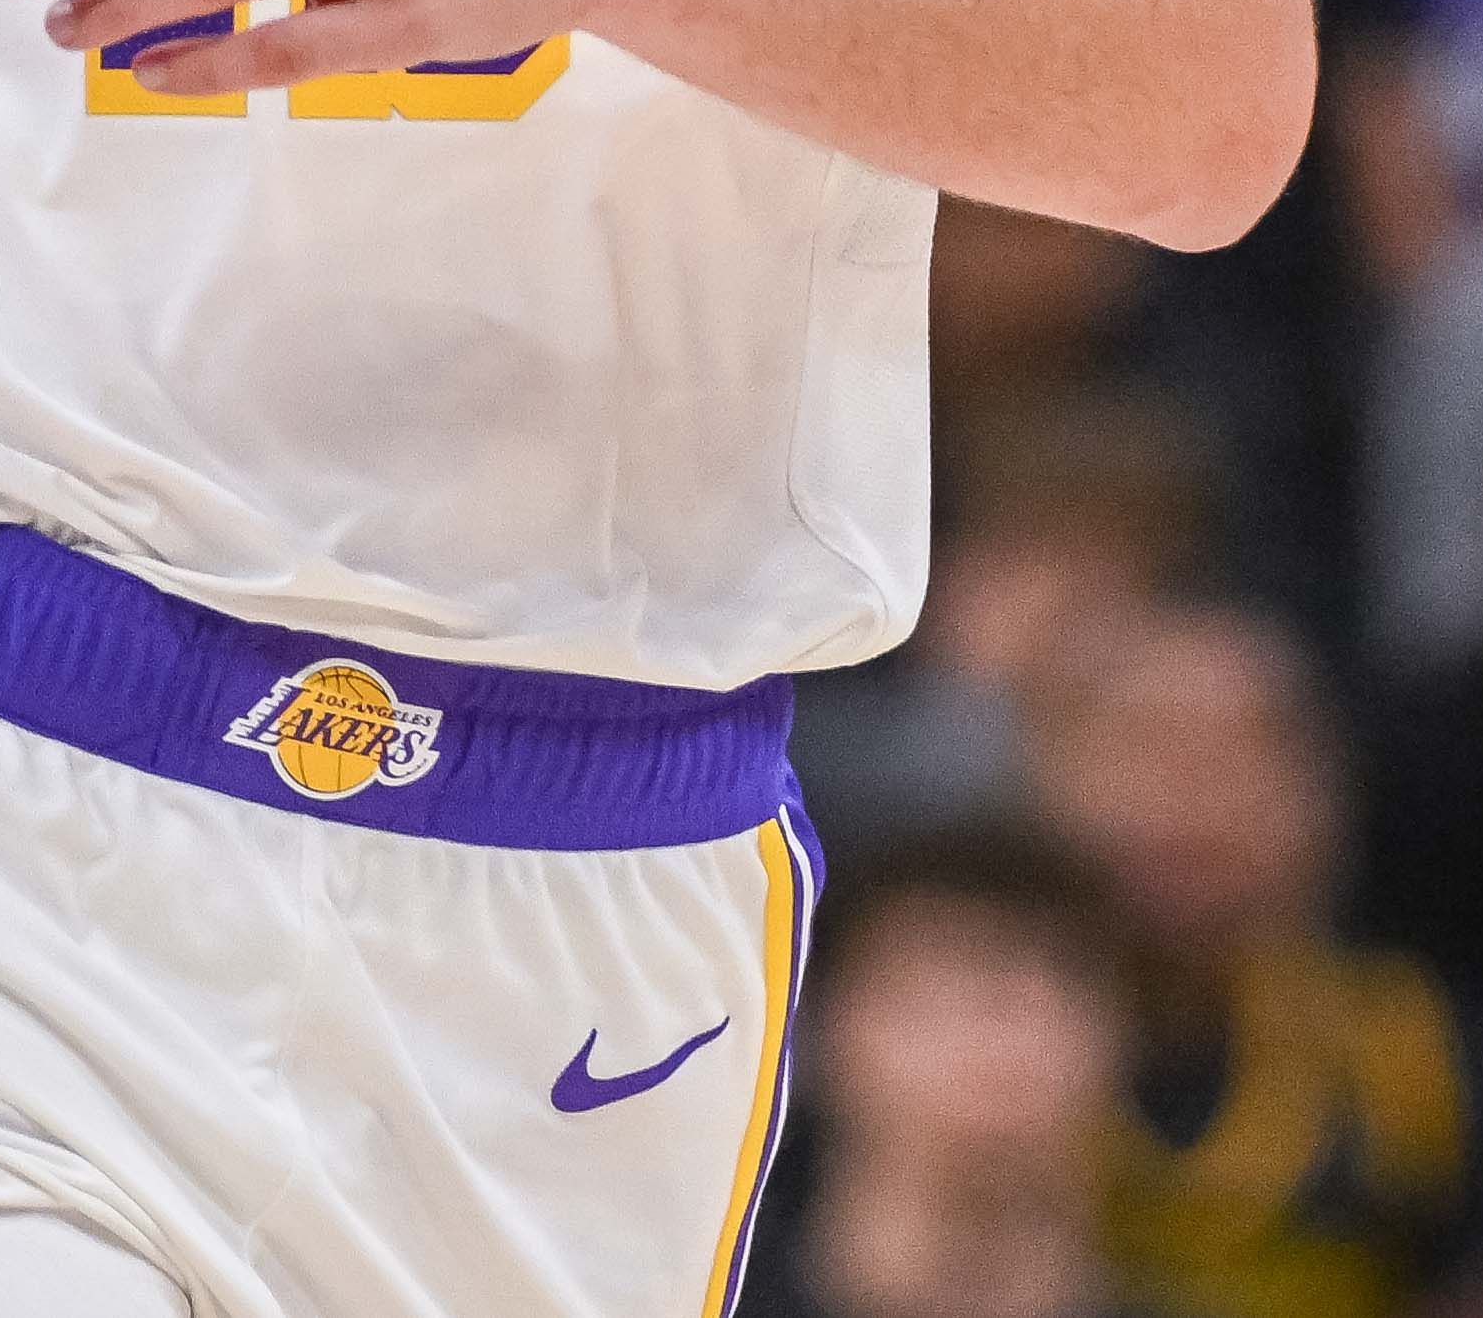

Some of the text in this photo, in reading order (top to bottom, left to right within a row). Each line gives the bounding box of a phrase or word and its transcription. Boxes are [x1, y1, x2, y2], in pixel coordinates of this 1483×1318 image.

[233, 683, 428, 779] LAKERS
[313, 692, 434, 728] LOS ANGELES
